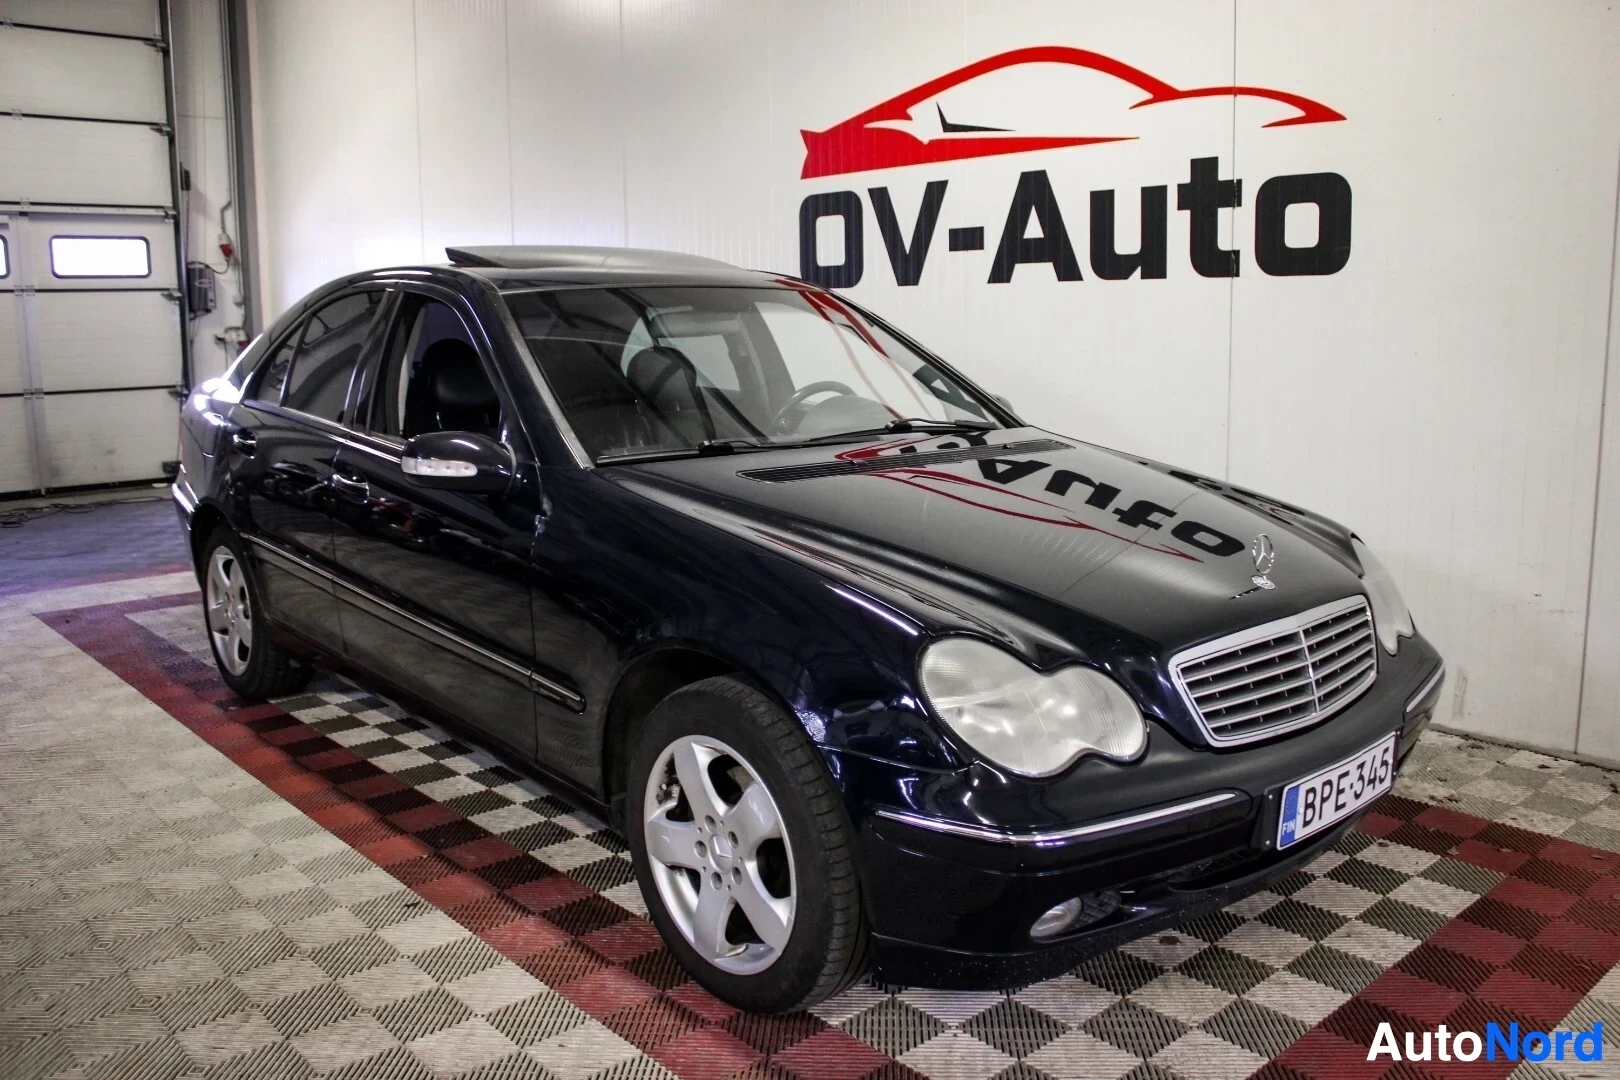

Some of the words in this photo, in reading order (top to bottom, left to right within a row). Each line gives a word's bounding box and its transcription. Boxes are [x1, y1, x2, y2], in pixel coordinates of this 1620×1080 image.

[799, 156, 1352, 288] OV-Auto
[1282, 819, 1296, 836] FIN
[1302, 746, 1390, 829] BPE-345
